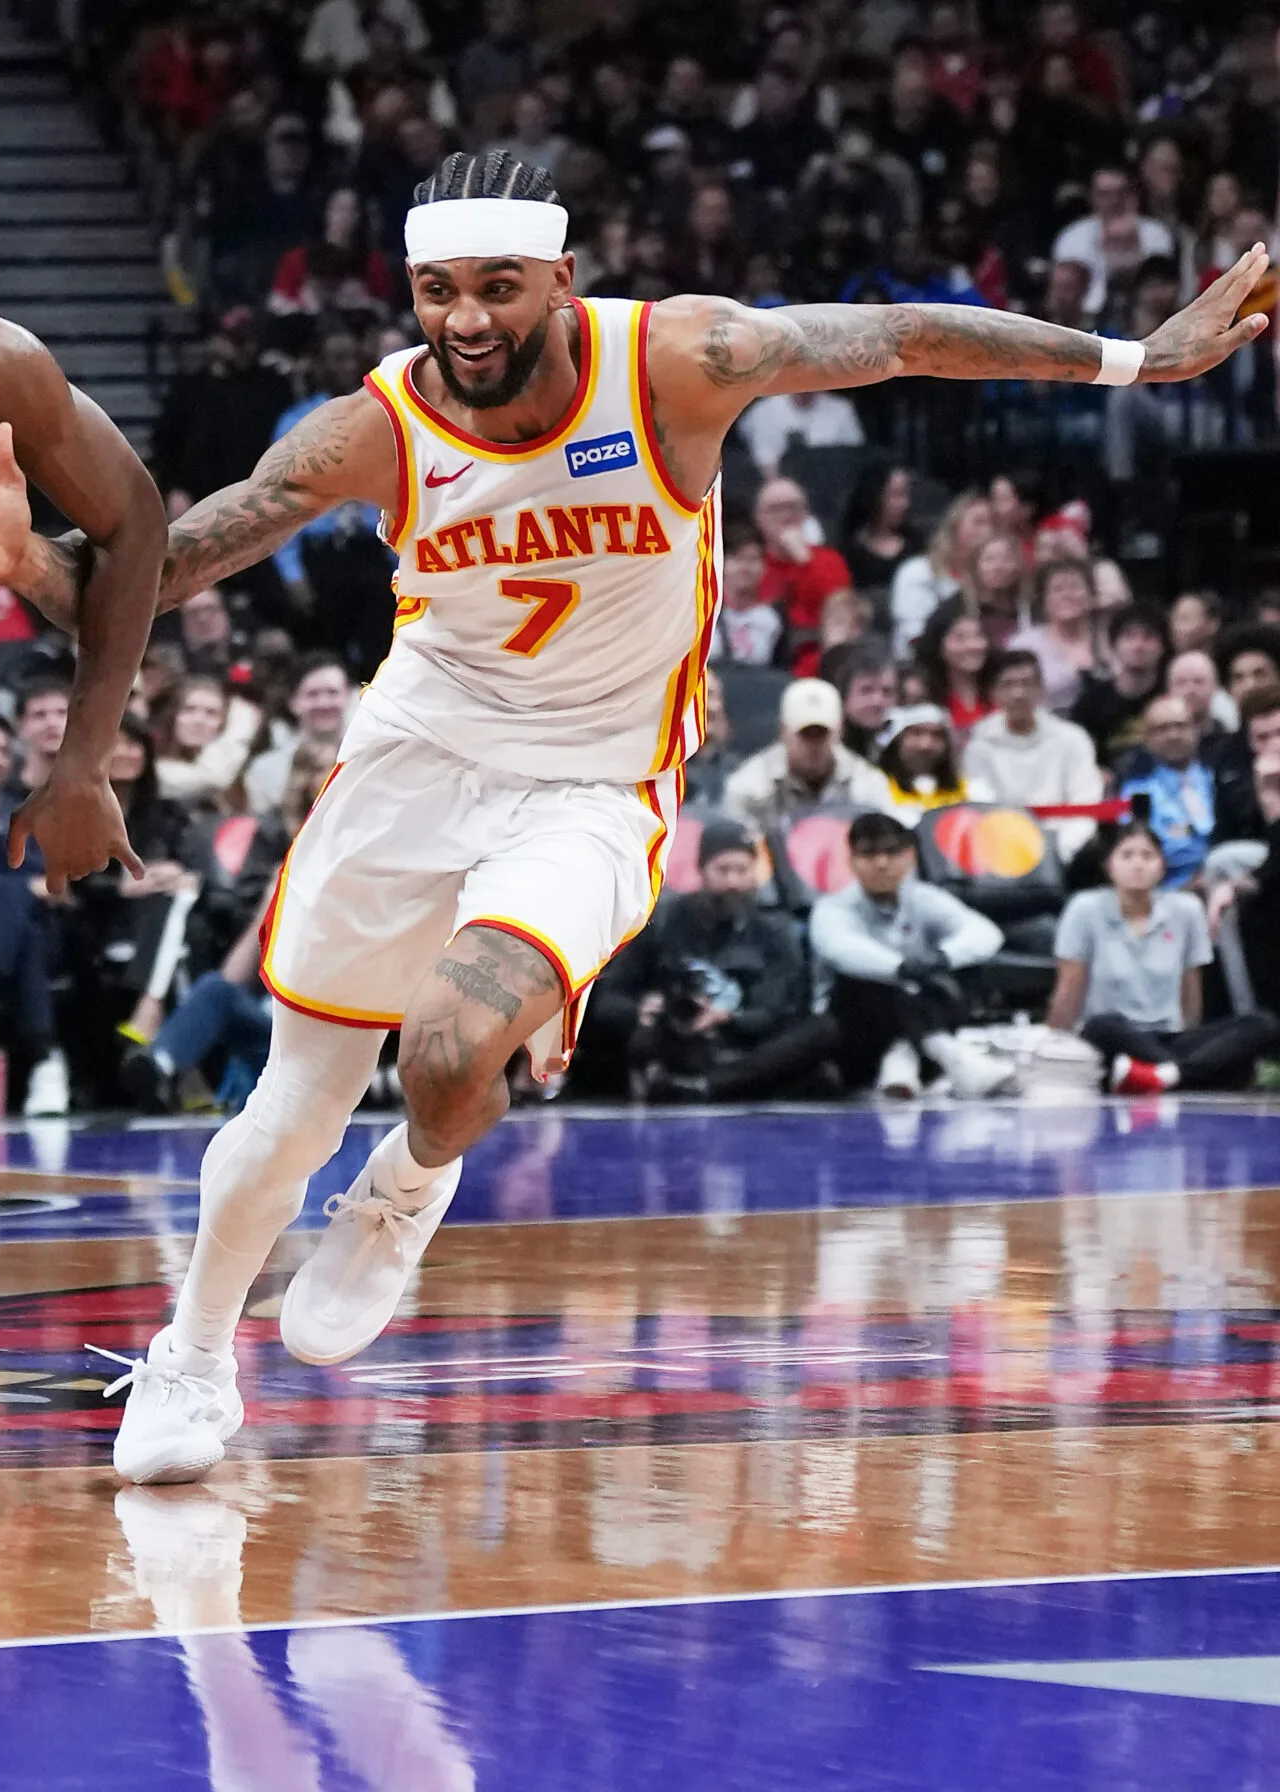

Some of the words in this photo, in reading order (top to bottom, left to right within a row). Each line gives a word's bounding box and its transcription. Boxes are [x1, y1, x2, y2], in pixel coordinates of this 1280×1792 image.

[570, 441, 631, 471] paze
[414, 503, 672, 574] ATLANTA
[497, 577, 582, 660] 7
